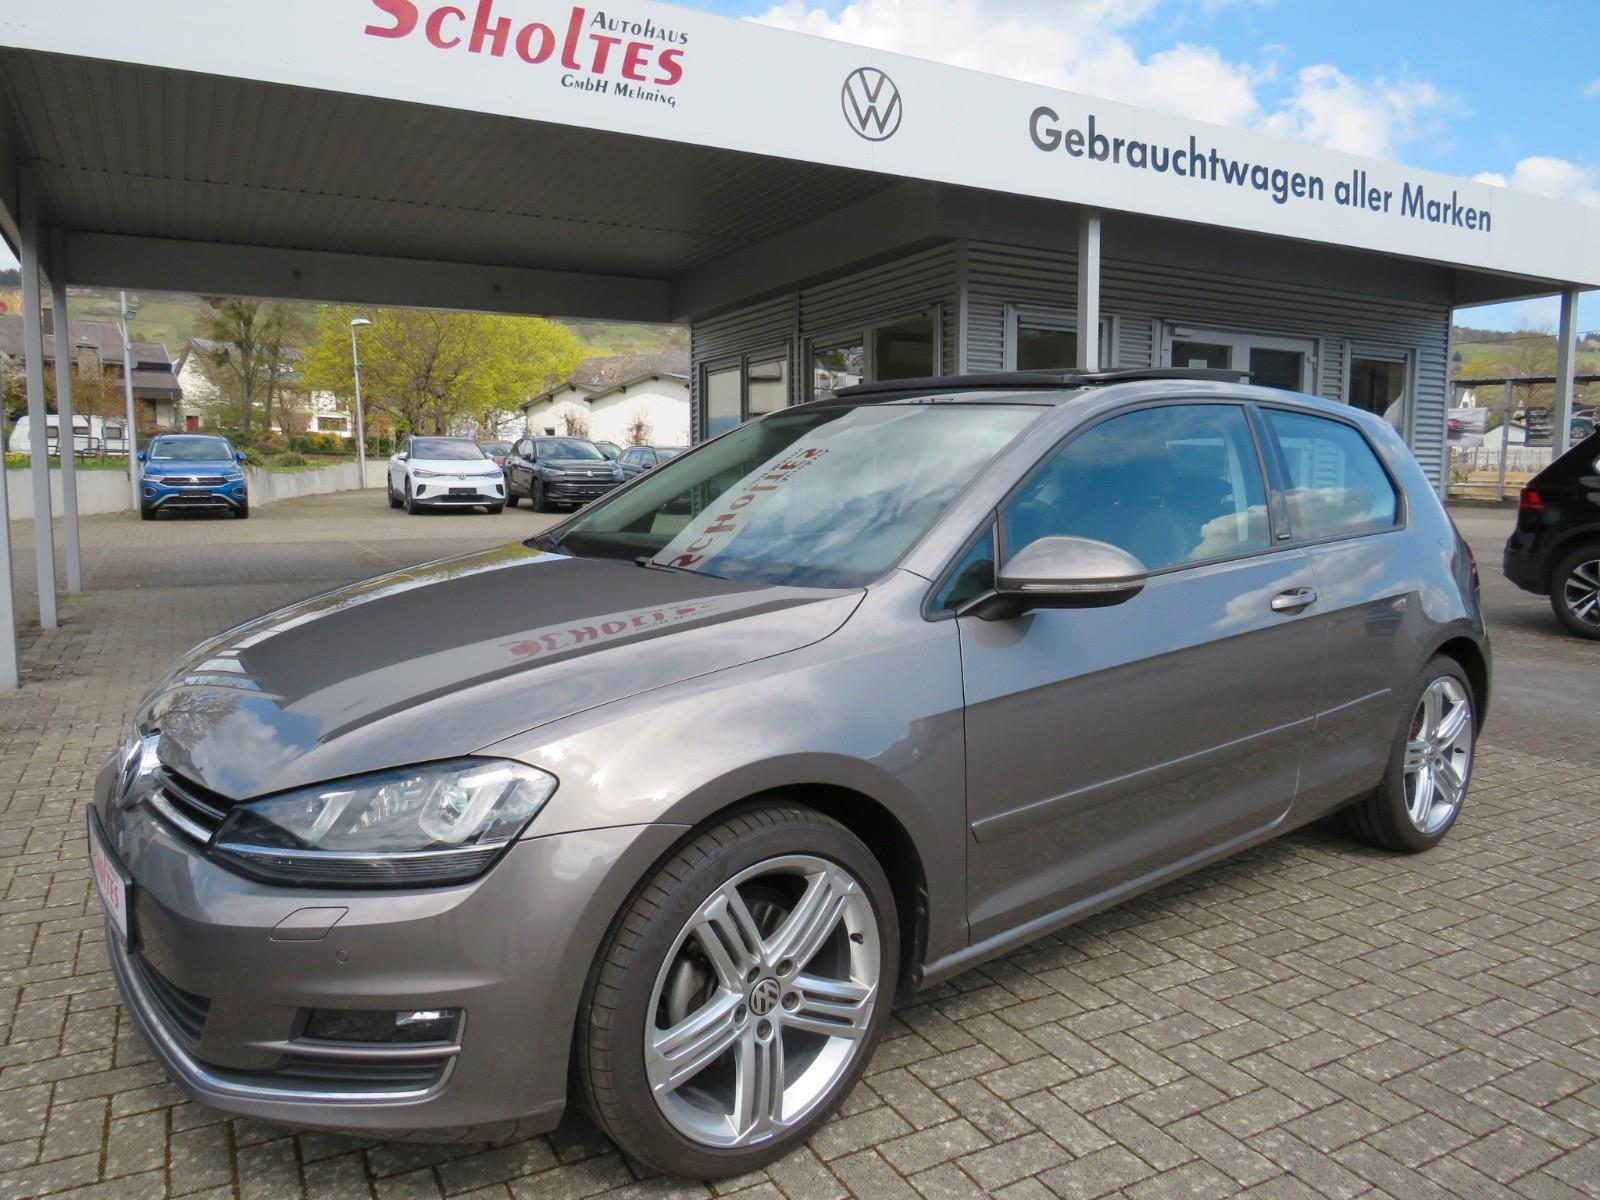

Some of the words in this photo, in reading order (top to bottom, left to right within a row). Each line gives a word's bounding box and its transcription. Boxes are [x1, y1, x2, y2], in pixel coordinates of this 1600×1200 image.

[1029, 105, 1325, 205] Gebrauchtwagen
[1334, 169, 1393, 213] aller
[1400, 181, 1492, 233] Marken
